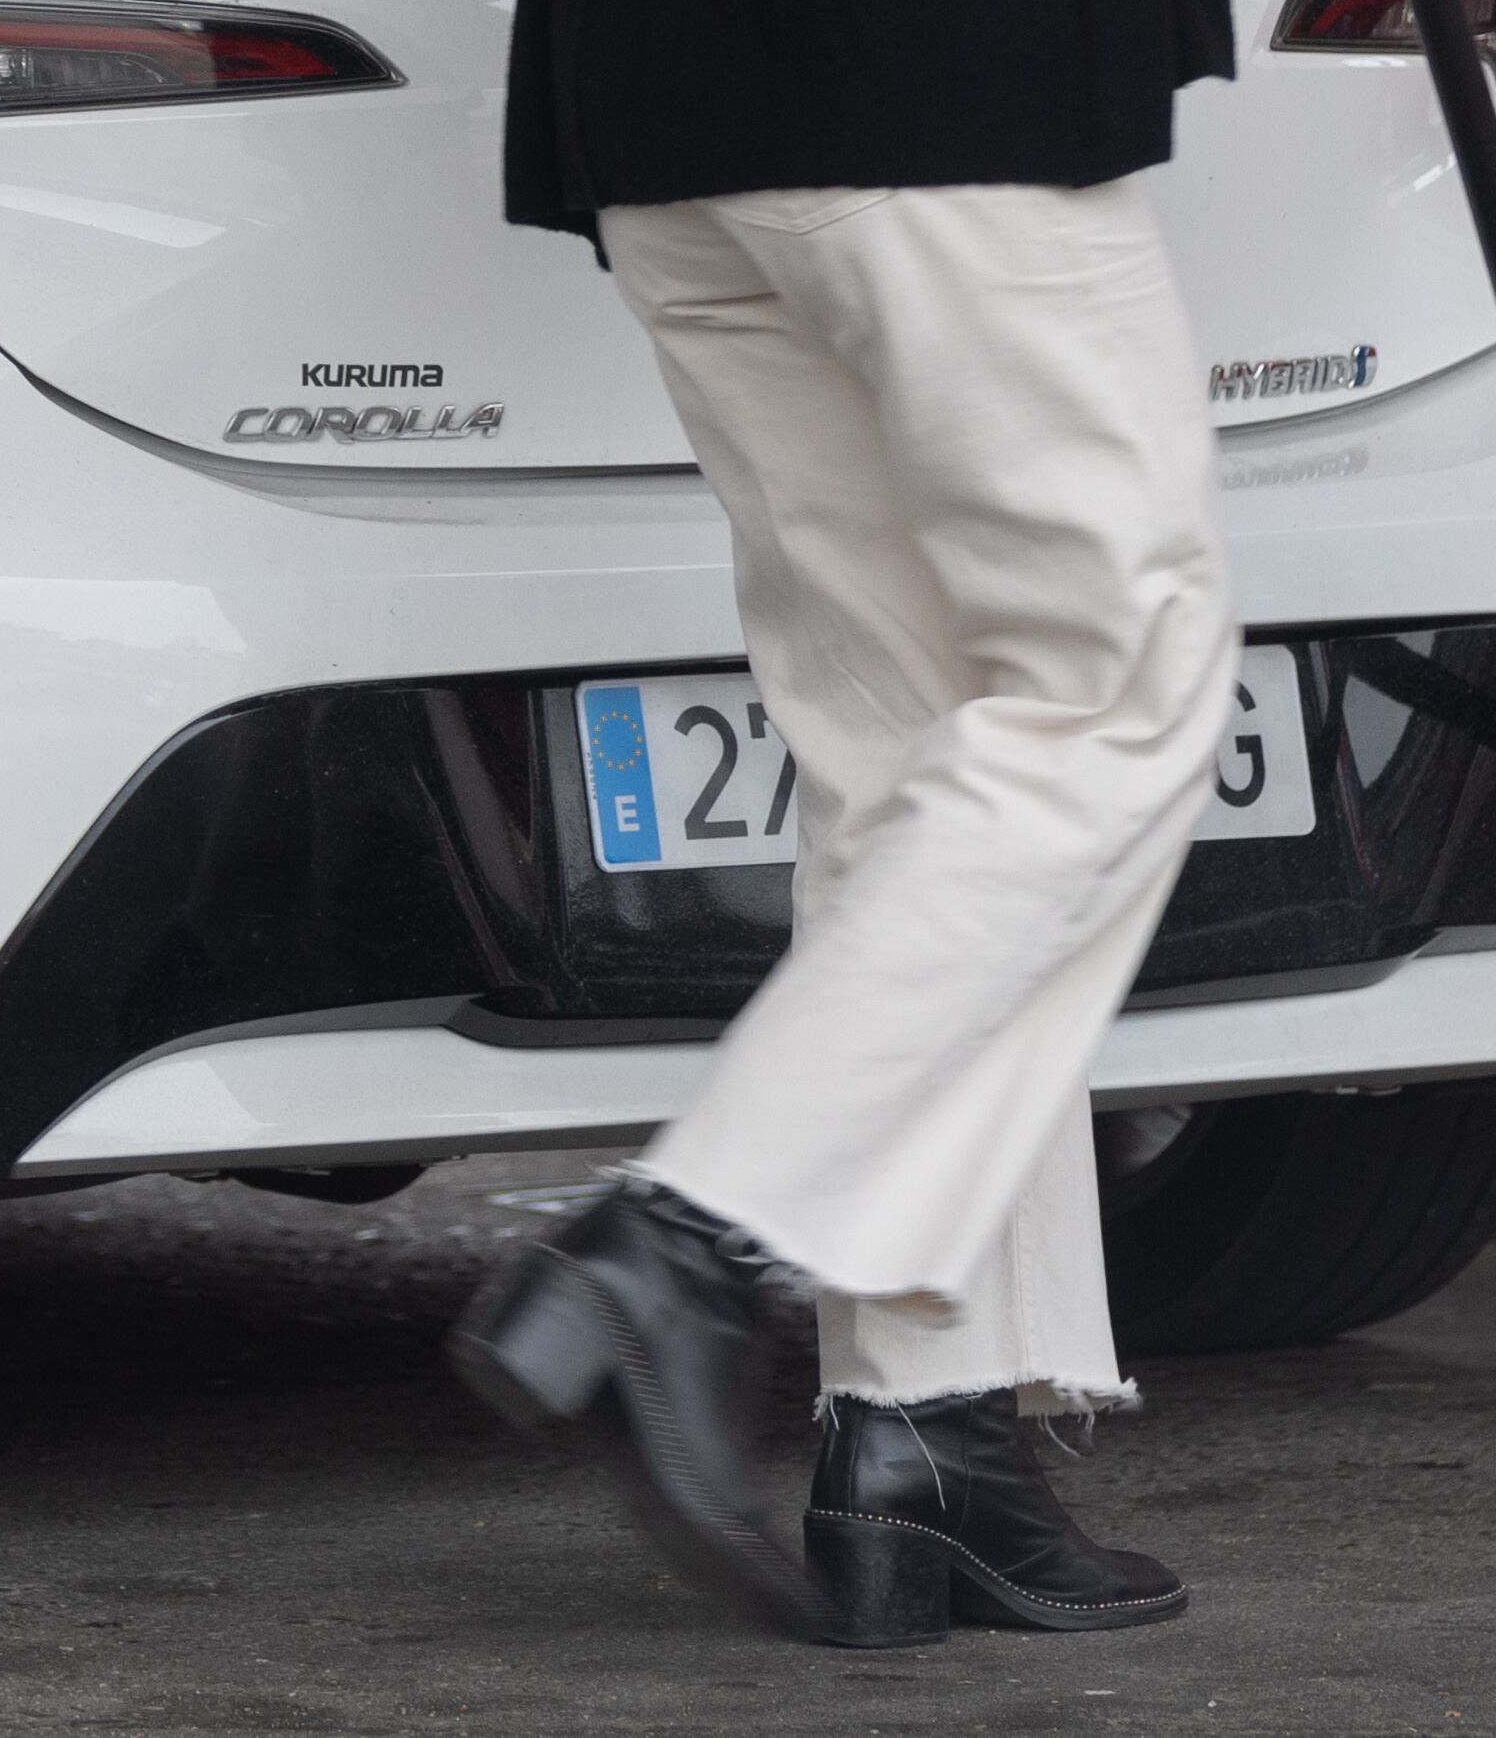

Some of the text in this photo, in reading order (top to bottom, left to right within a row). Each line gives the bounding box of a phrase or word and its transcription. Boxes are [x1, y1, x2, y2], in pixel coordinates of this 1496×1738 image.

[1208, 354, 1352, 402] HYBRID
[222, 401, 504, 444] COROLLA
[614, 794, 640, 832] E
